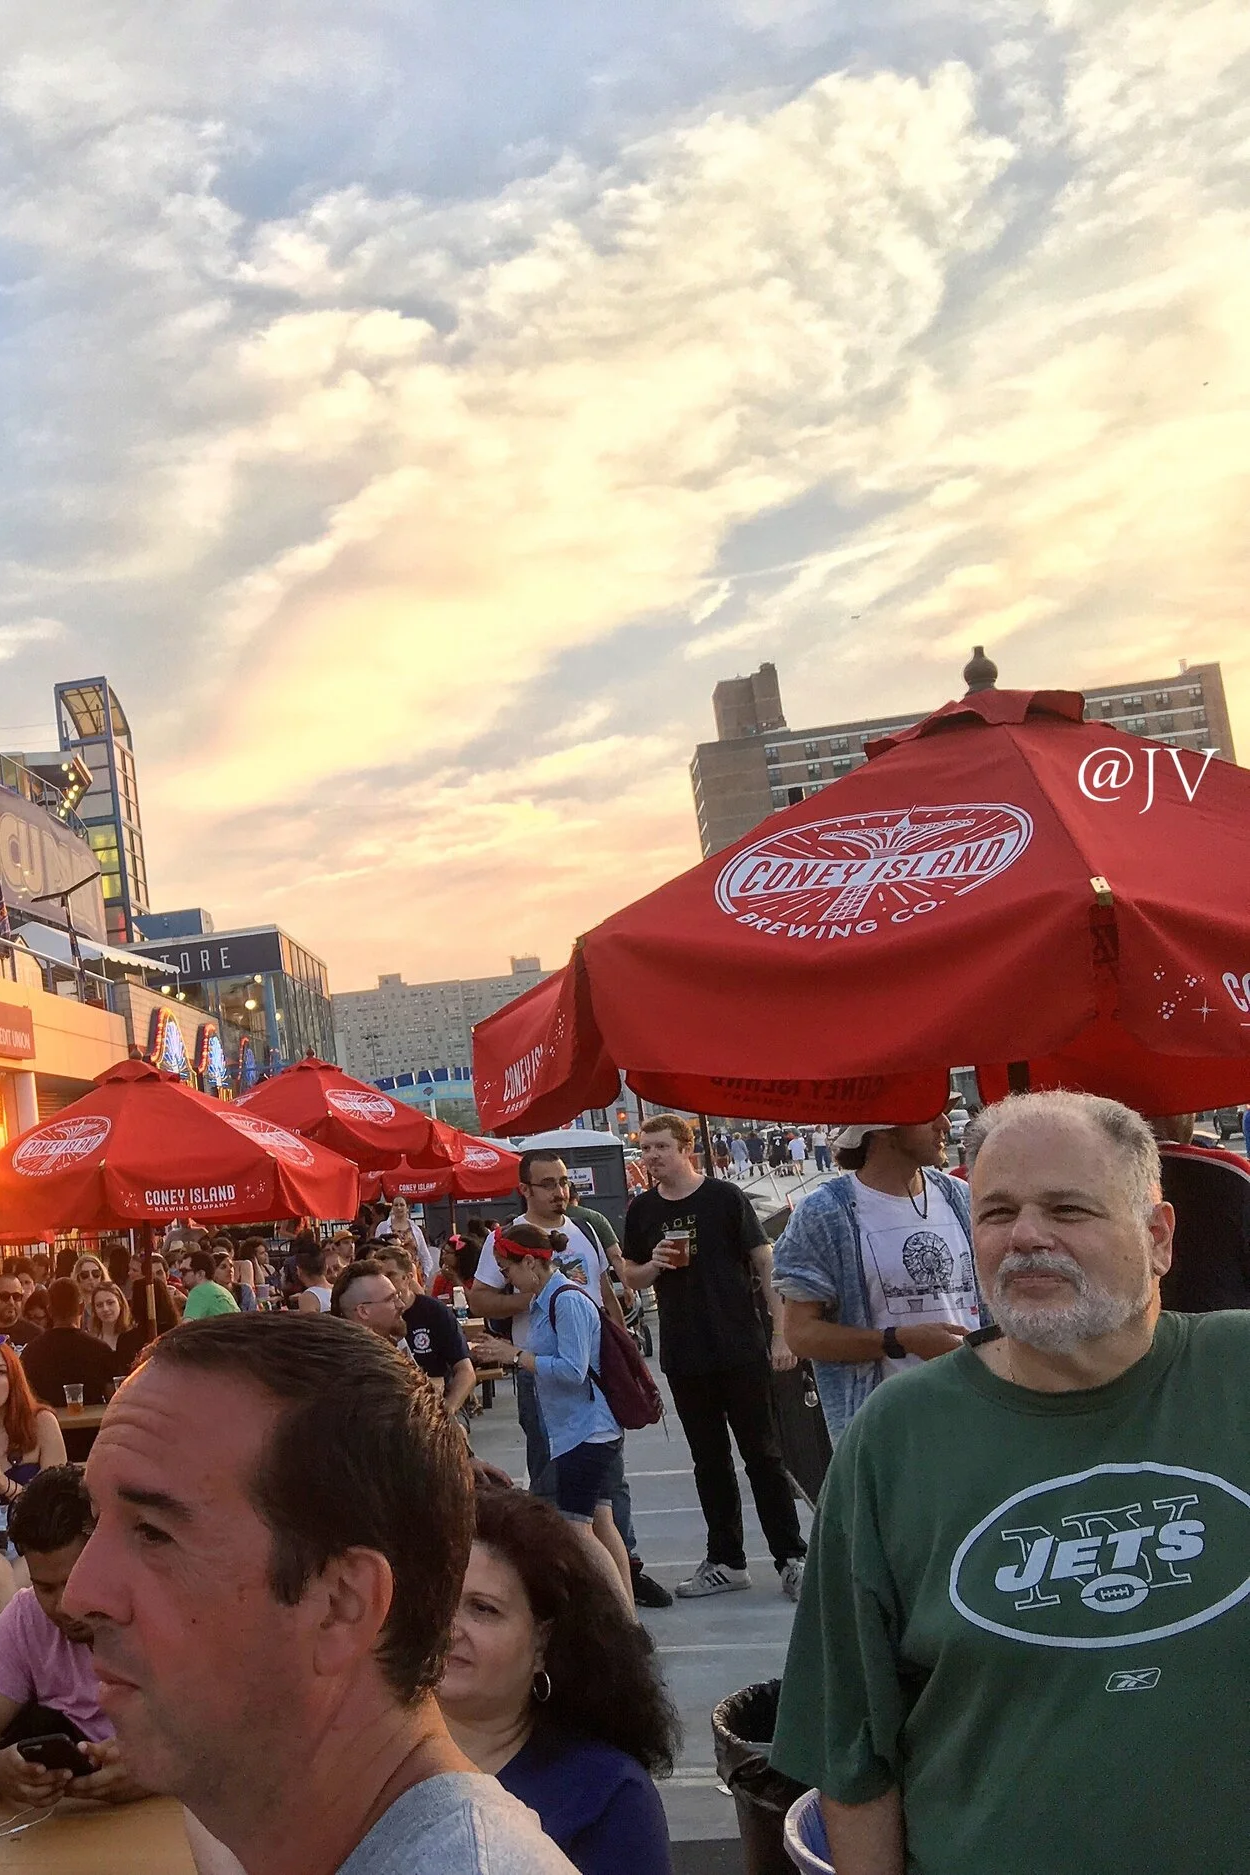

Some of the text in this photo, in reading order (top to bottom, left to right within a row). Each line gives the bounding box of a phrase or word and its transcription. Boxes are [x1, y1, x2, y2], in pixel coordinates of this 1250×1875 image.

[739, 836, 1008, 894] CONEY ISLAND
[735, 911, 878, 940] BREWING
[10, 1030, 31, 1050] UNION
[503, 1053, 532, 1102] CONEY
[21, 1135, 101, 1158] CONEY ISLAND
[15, 1165, 53, 1177] BREWING
[145, 1184, 236, 1206] CONEY ISLAND
[398, 1181, 437, 1192] CONEY ISLAND
[191, 1201, 230, 1211] COMPANY
[993, 1519, 1207, 1592] JETS
